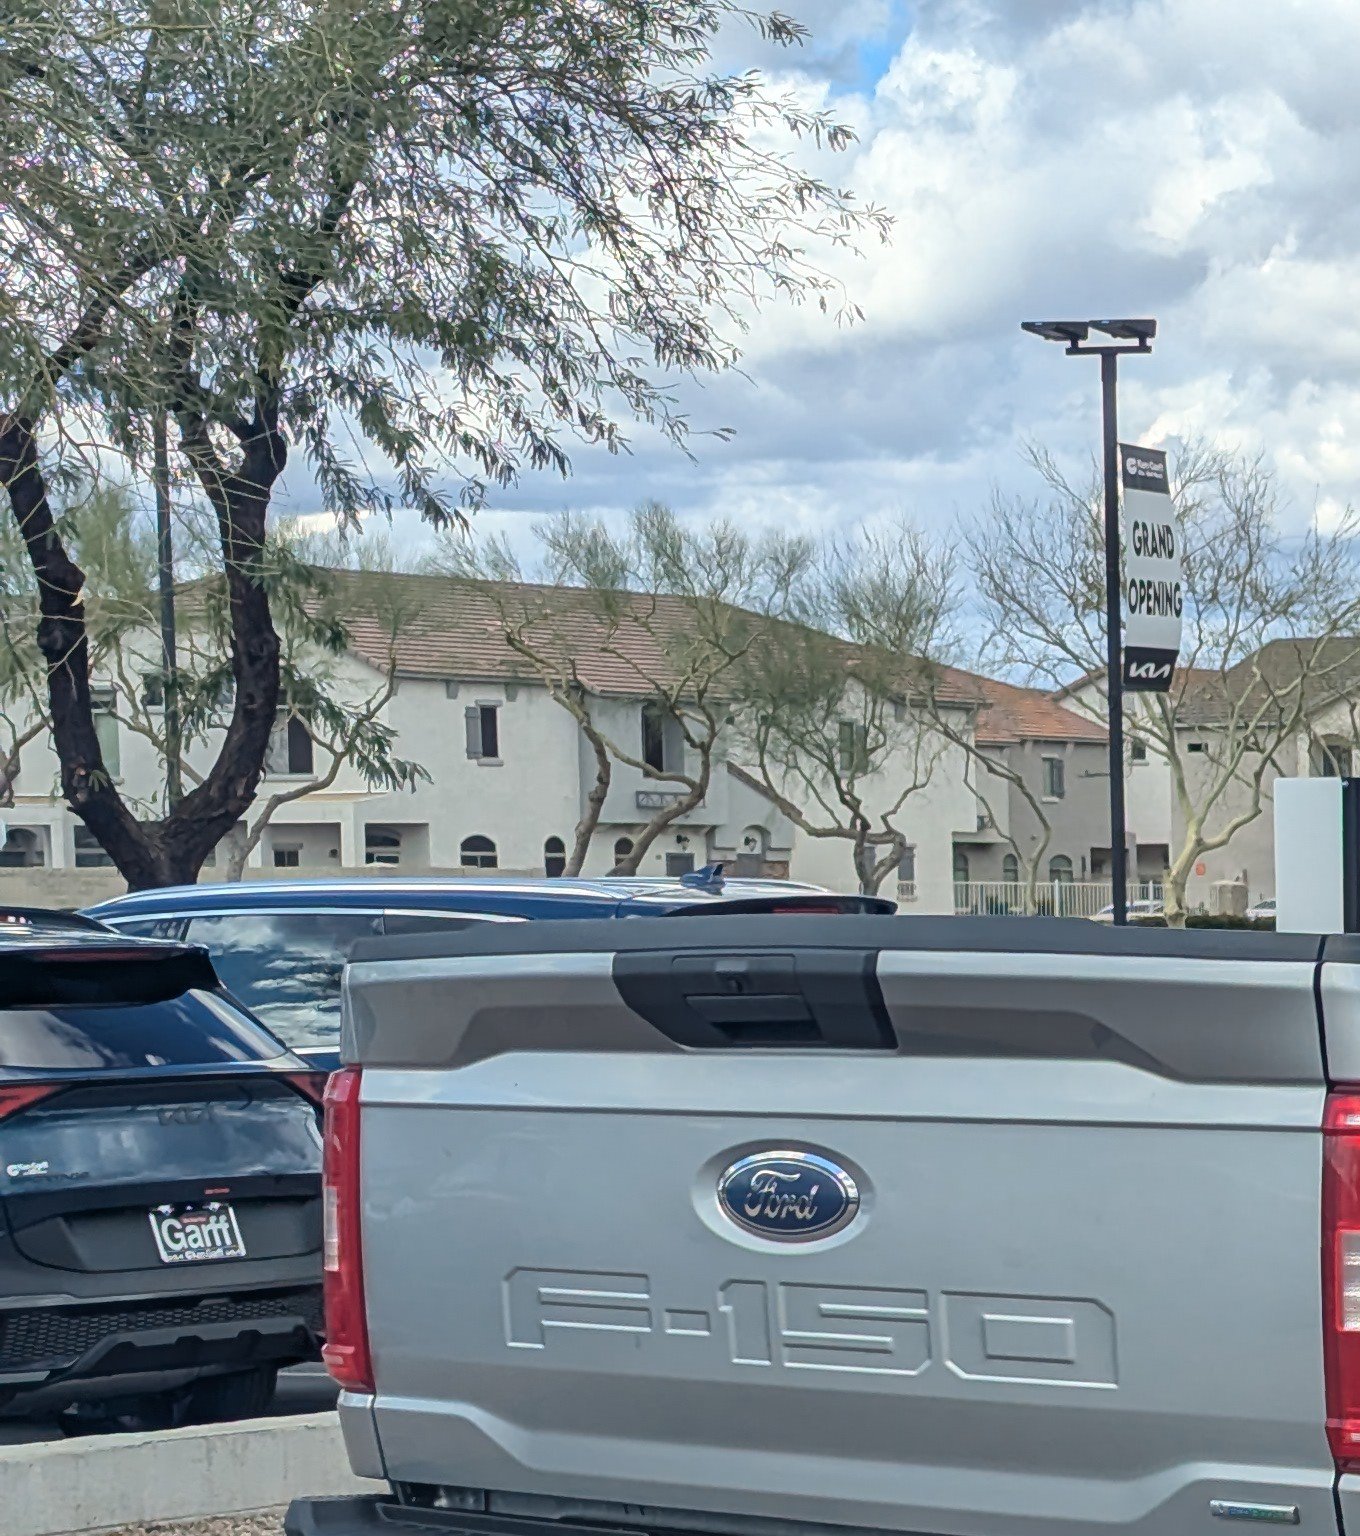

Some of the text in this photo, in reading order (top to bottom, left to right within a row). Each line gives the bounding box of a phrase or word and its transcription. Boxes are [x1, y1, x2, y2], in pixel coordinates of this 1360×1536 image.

[1132, 520, 1175, 560] GRAND
[1128, 578, 1183, 618] OPENING
[744, 1169, 820, 1219] Ford
[161, 1214, 232, 1251] Garff
[502, 1265, 1119, 1389] F-150
